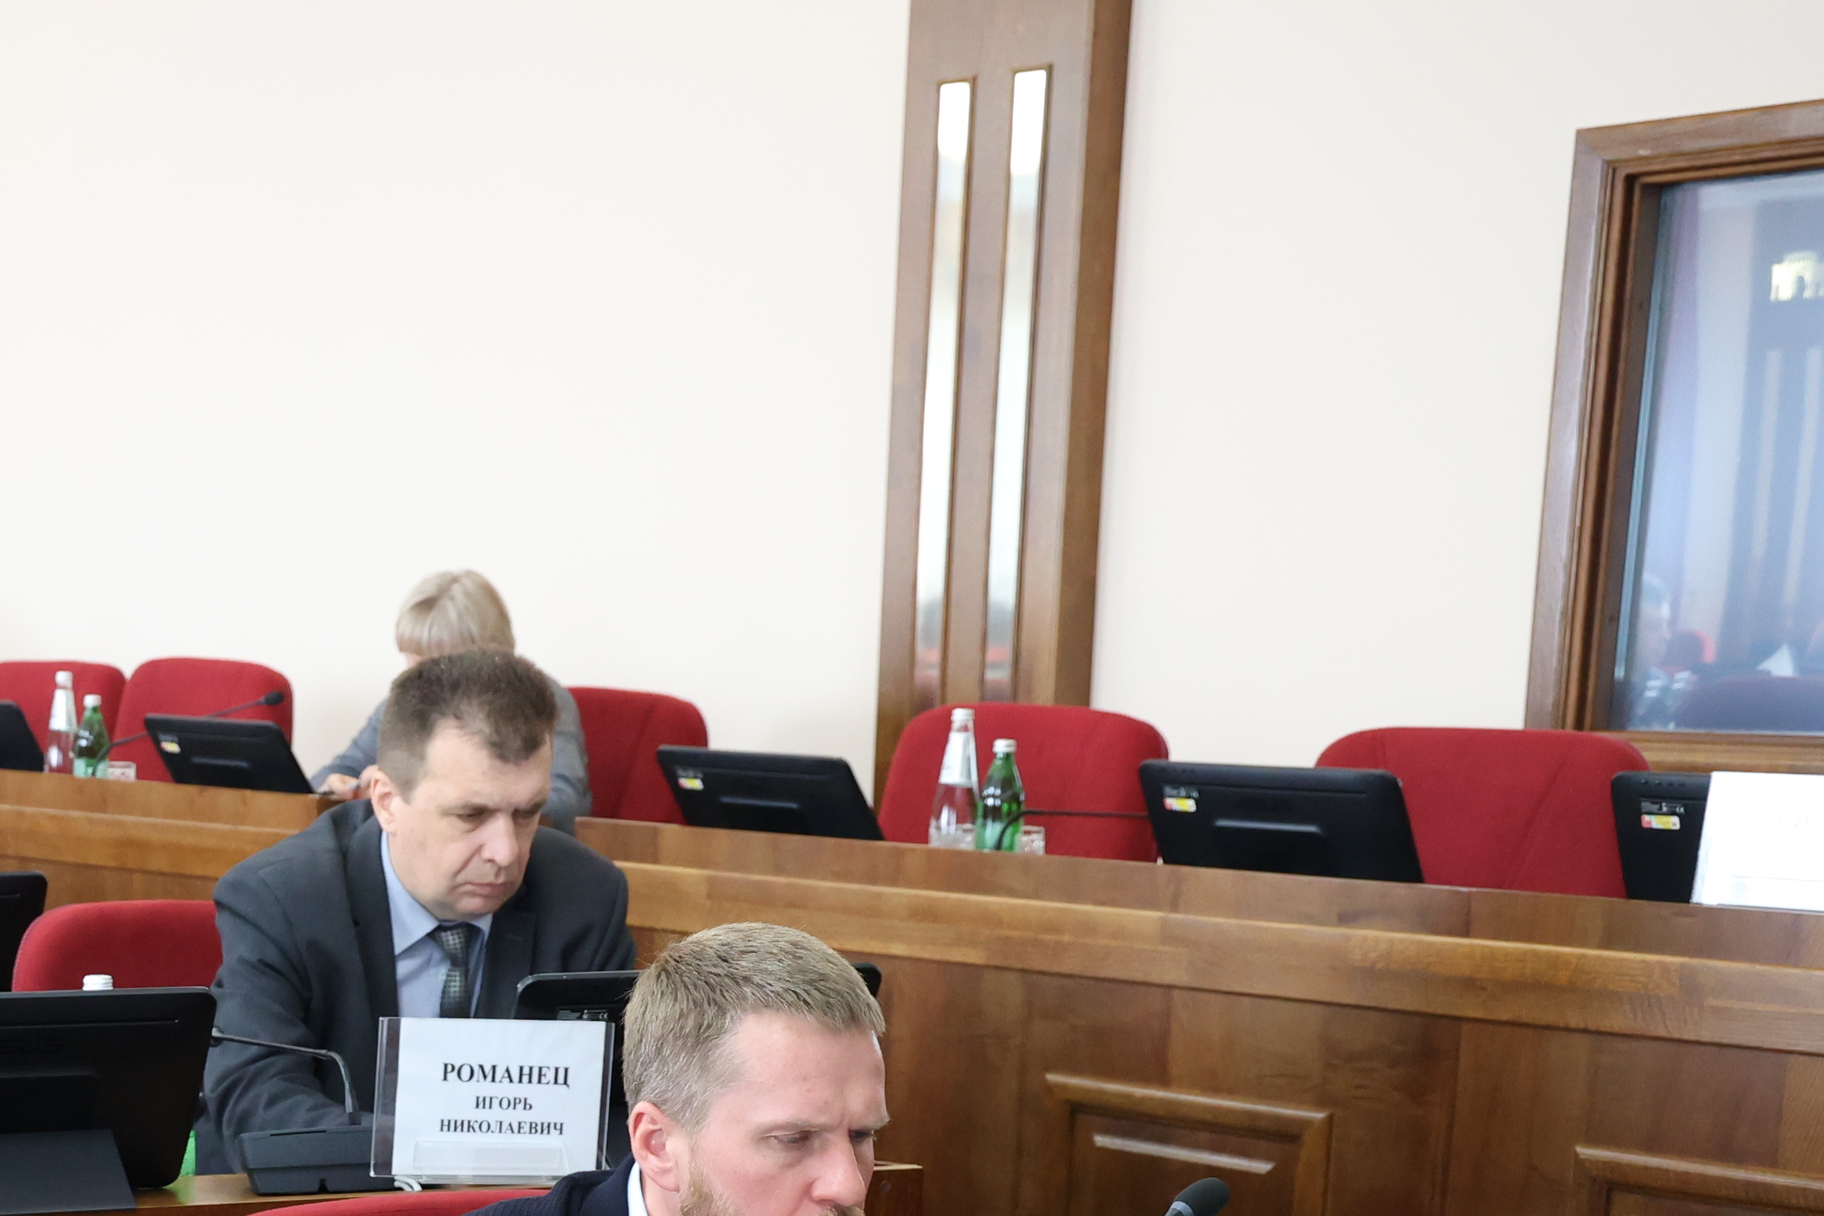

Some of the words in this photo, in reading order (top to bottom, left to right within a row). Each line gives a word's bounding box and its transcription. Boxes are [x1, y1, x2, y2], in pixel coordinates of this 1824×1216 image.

[441, 1062, 571, 1089] РОМАНЕЦ
[474, 1095, 533, 1111] ИГОРЬ
[439, 1118, 565, 1136] НИКОЛАЕВИЧ
